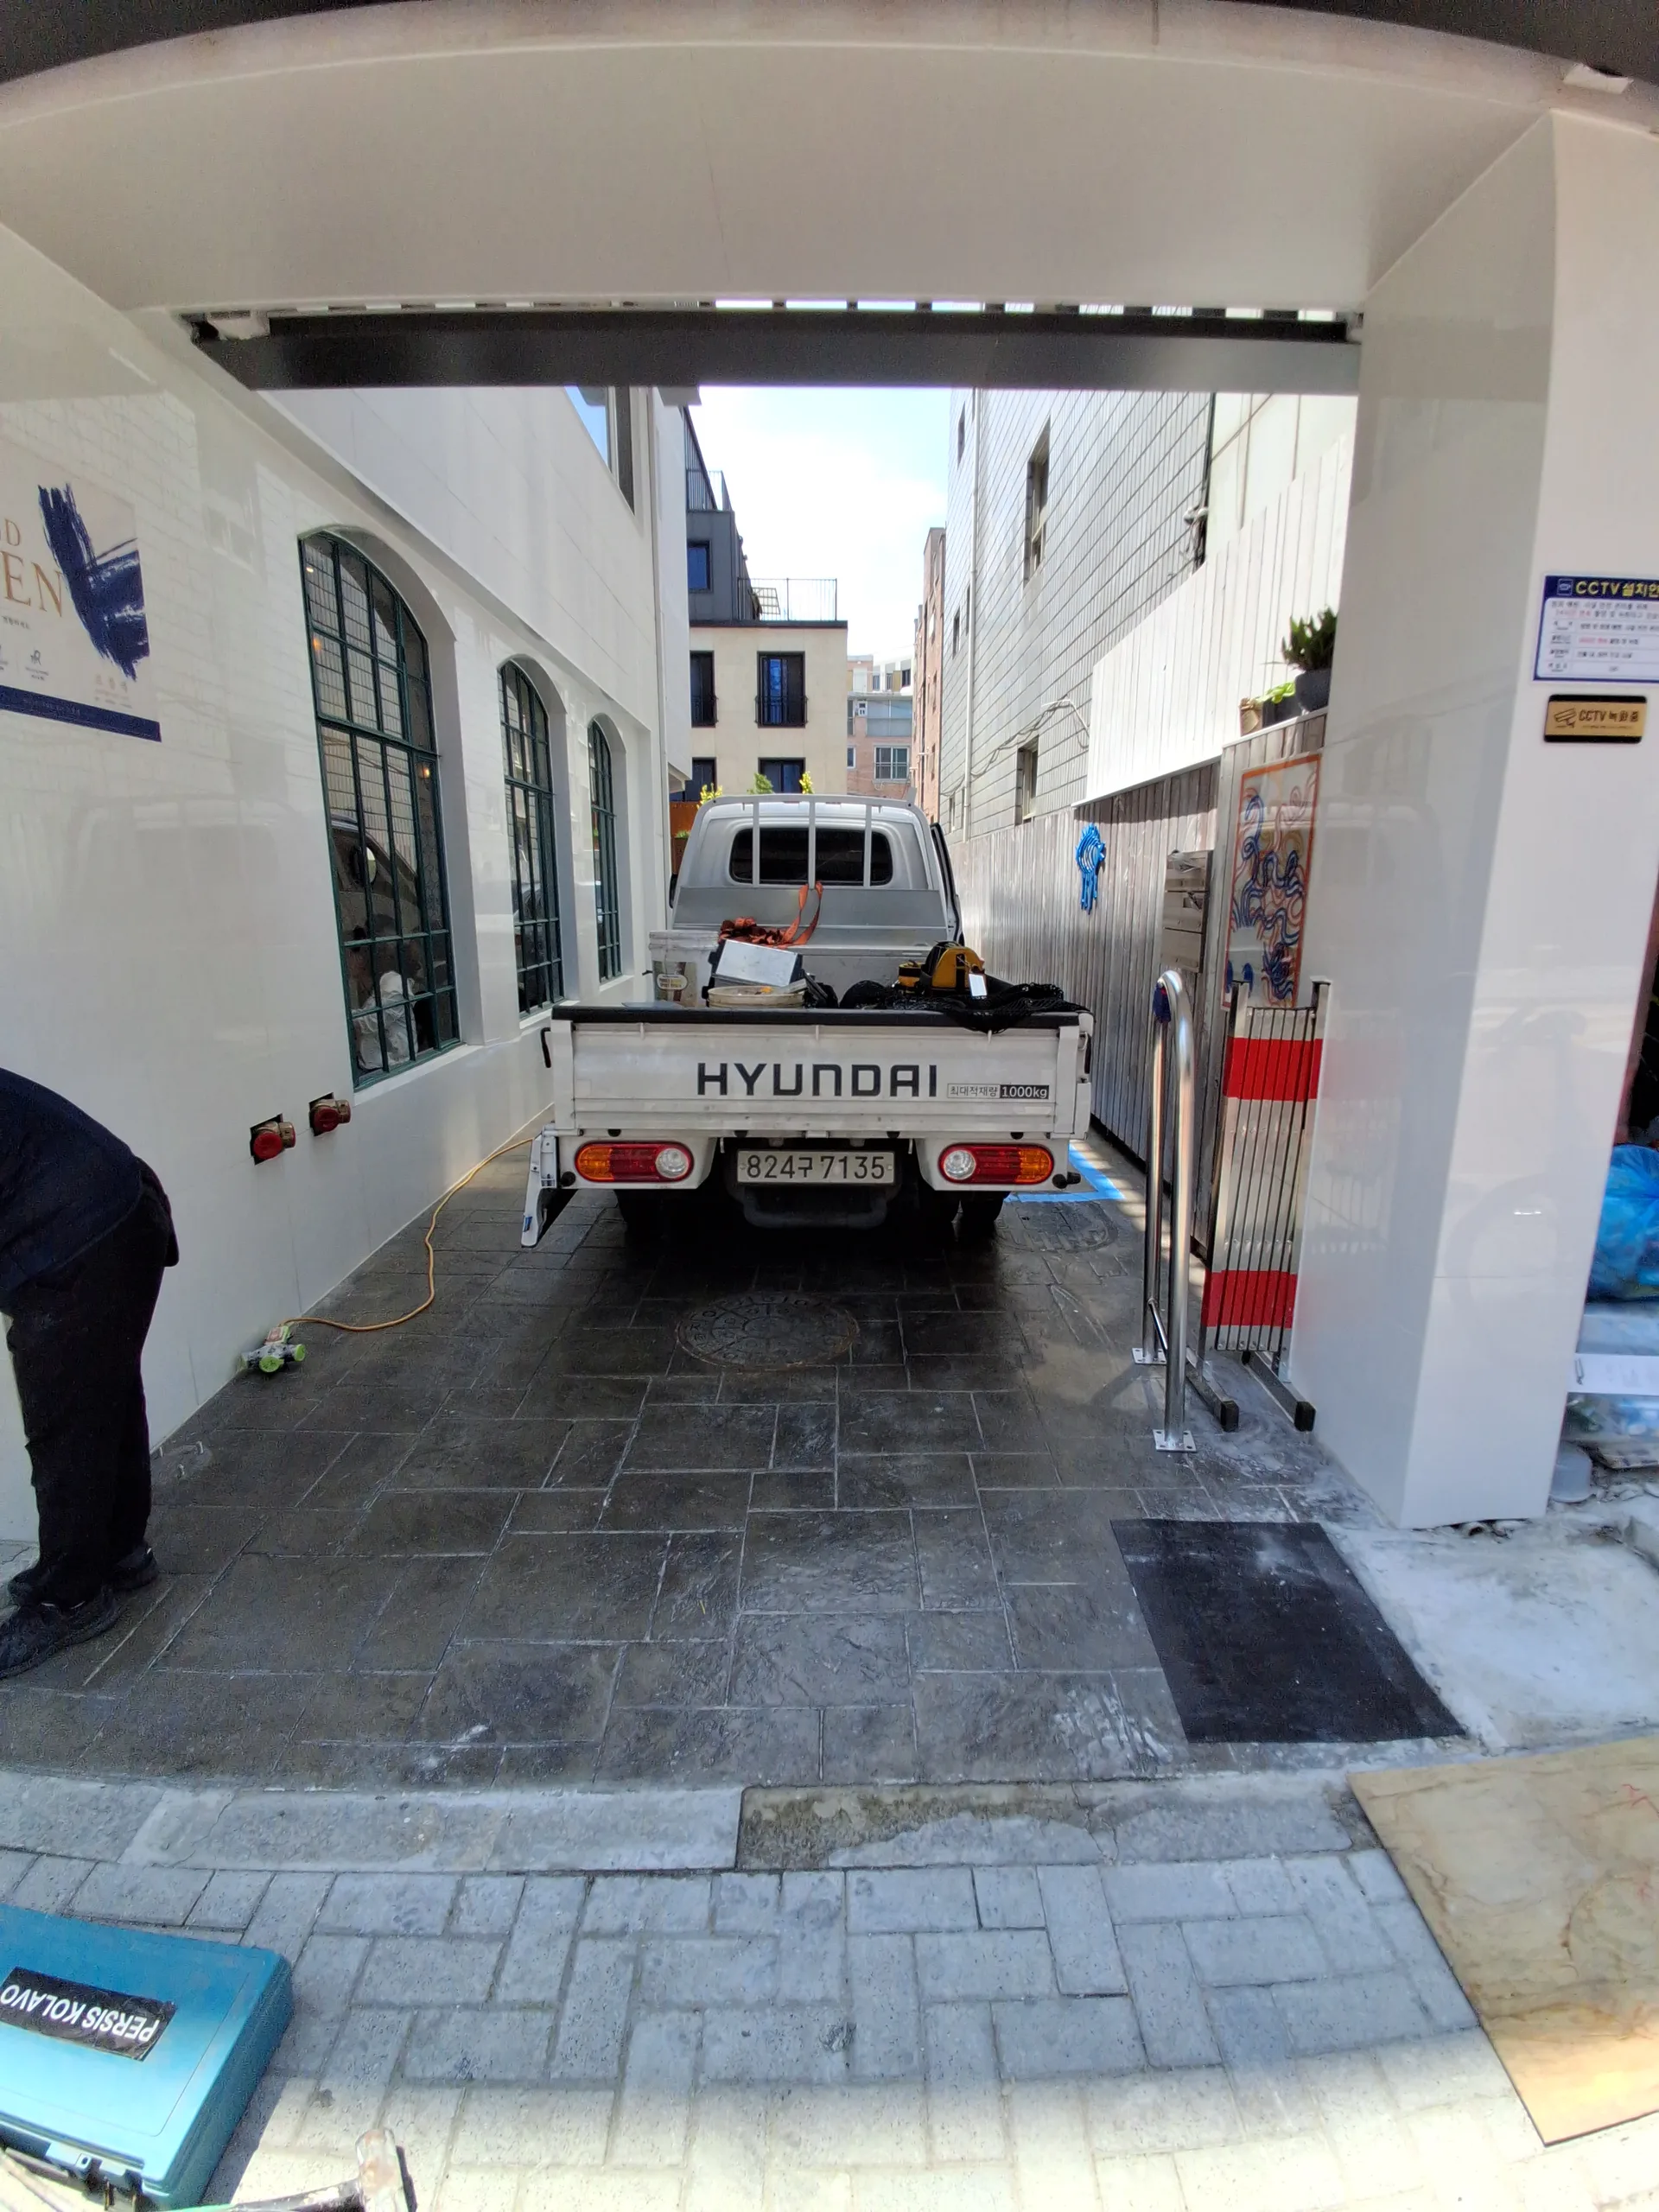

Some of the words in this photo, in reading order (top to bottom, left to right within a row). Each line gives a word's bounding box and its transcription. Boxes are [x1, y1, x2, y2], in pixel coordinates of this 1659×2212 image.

[1575, 581, 1621, 595] CCTV
[1579, 709, 1606, 722] CCTV
[697, 1062, 938, 1097] HYUNDAI
[950, 1085, 998, 1098] 최대적재량
[1001, 1085, 1047, 1099] 1000kg
[747, 1154, 814, 1179] 824구
[820, 1154, 886, 1179] 7135
[0, 1984, 86, 2024] KOLAVO
[81, 2006, 160, 2042] PERSIS
